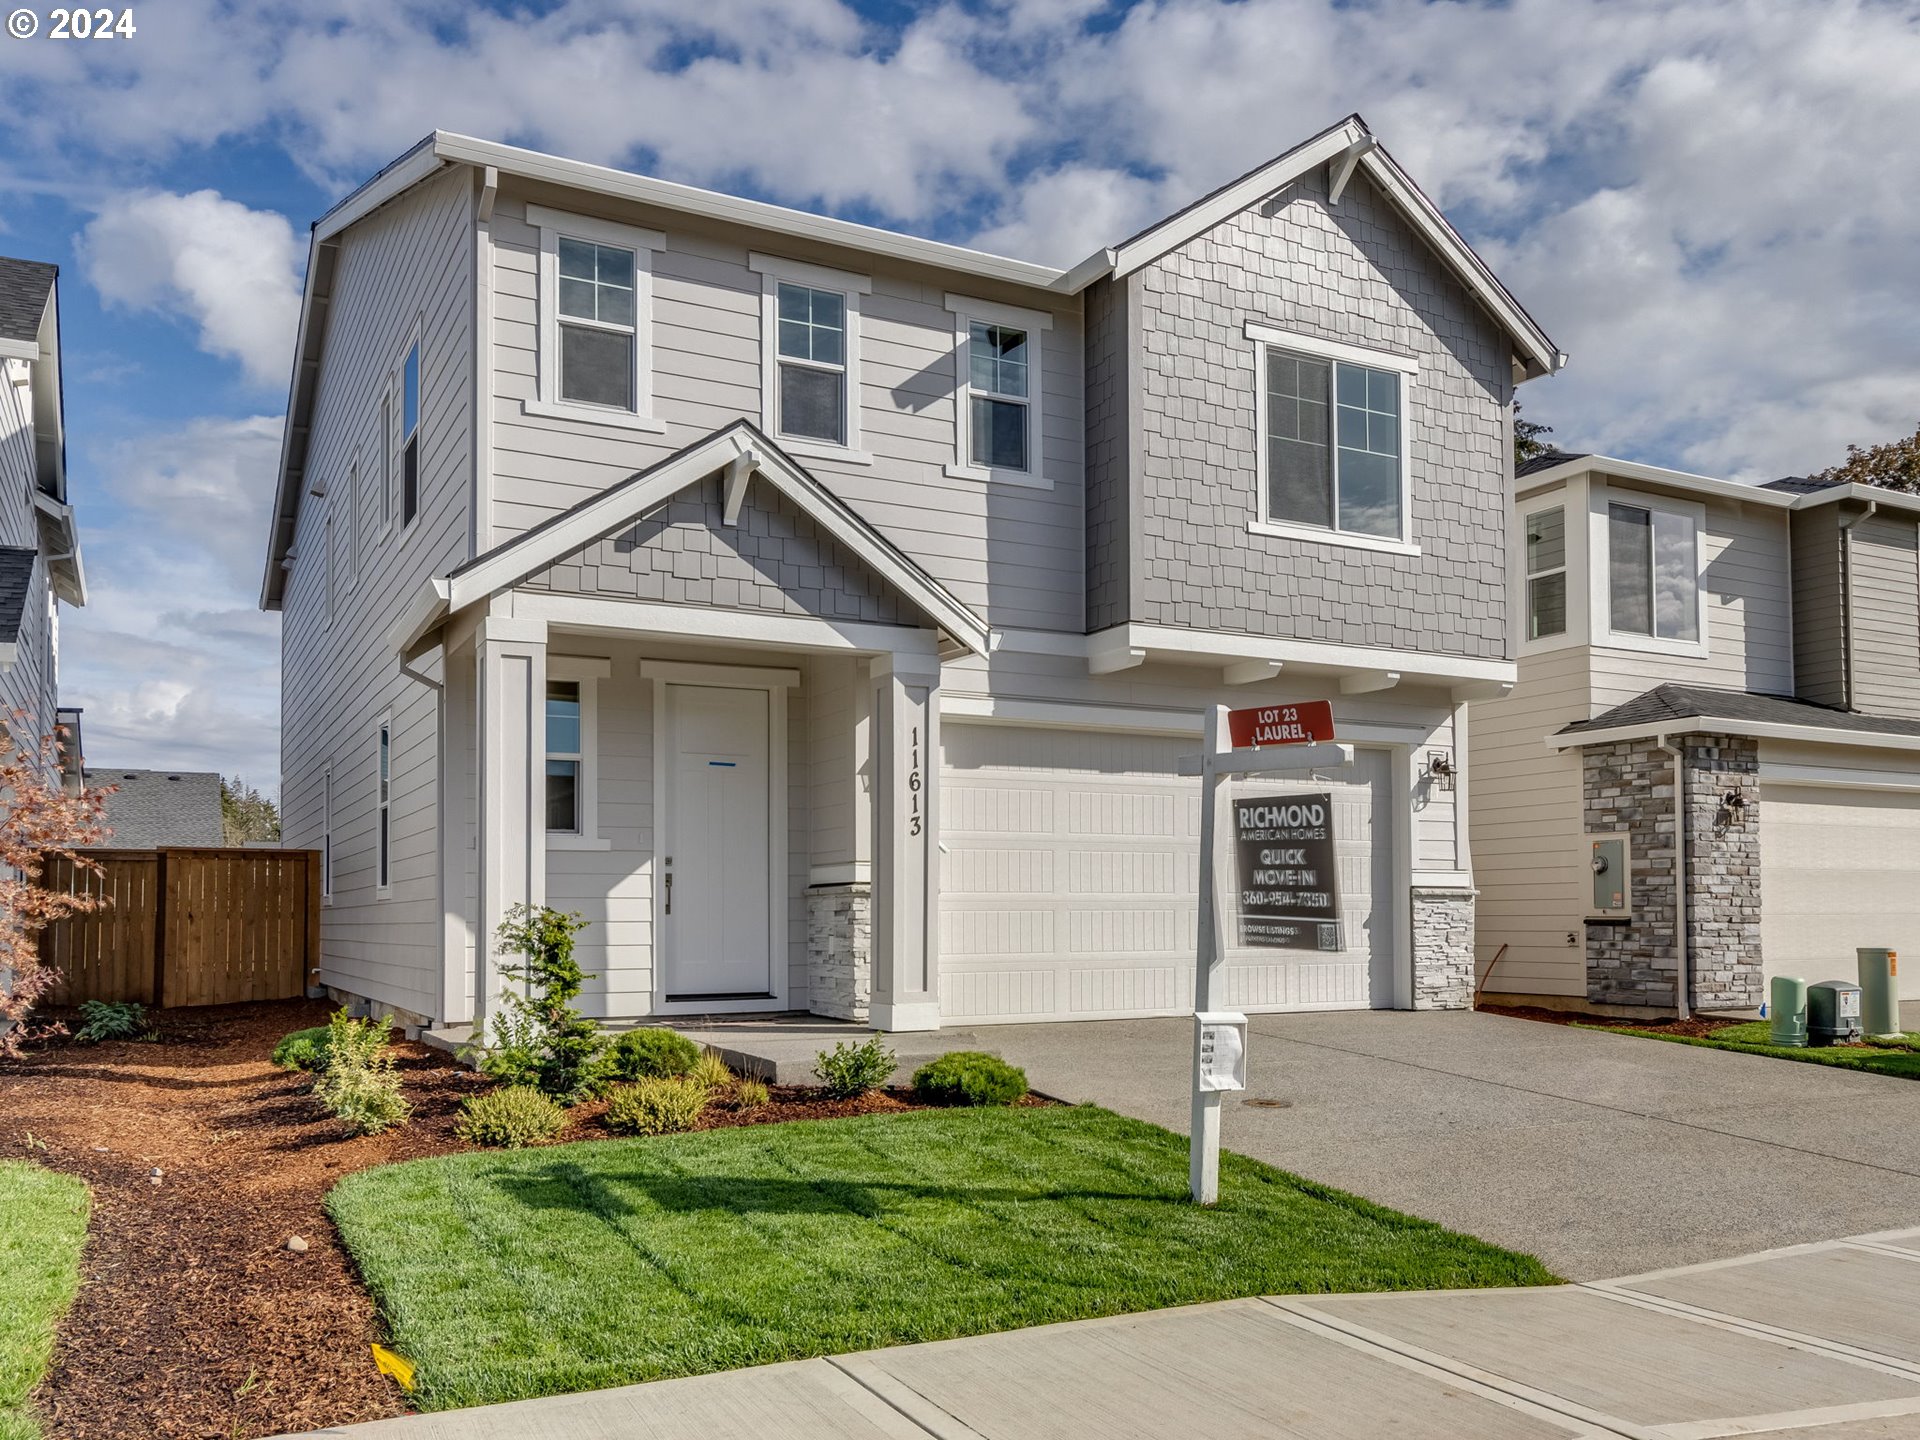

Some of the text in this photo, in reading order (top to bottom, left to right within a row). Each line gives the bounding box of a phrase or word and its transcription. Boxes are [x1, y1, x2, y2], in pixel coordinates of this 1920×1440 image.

[1258, 707, 1298, 724] LOT 23
[1255, 723, 1306, 742] LAUREL
[909, 726, 922, 837] 11613
[1239, 804, 1325, 828] RICHMOND
[1240, 828, 1327, 841] AMERICAN HOMES
[1260, 848, 1307, 865] QUICK
[1253, 868, 1317, 887] MOVE-IN
